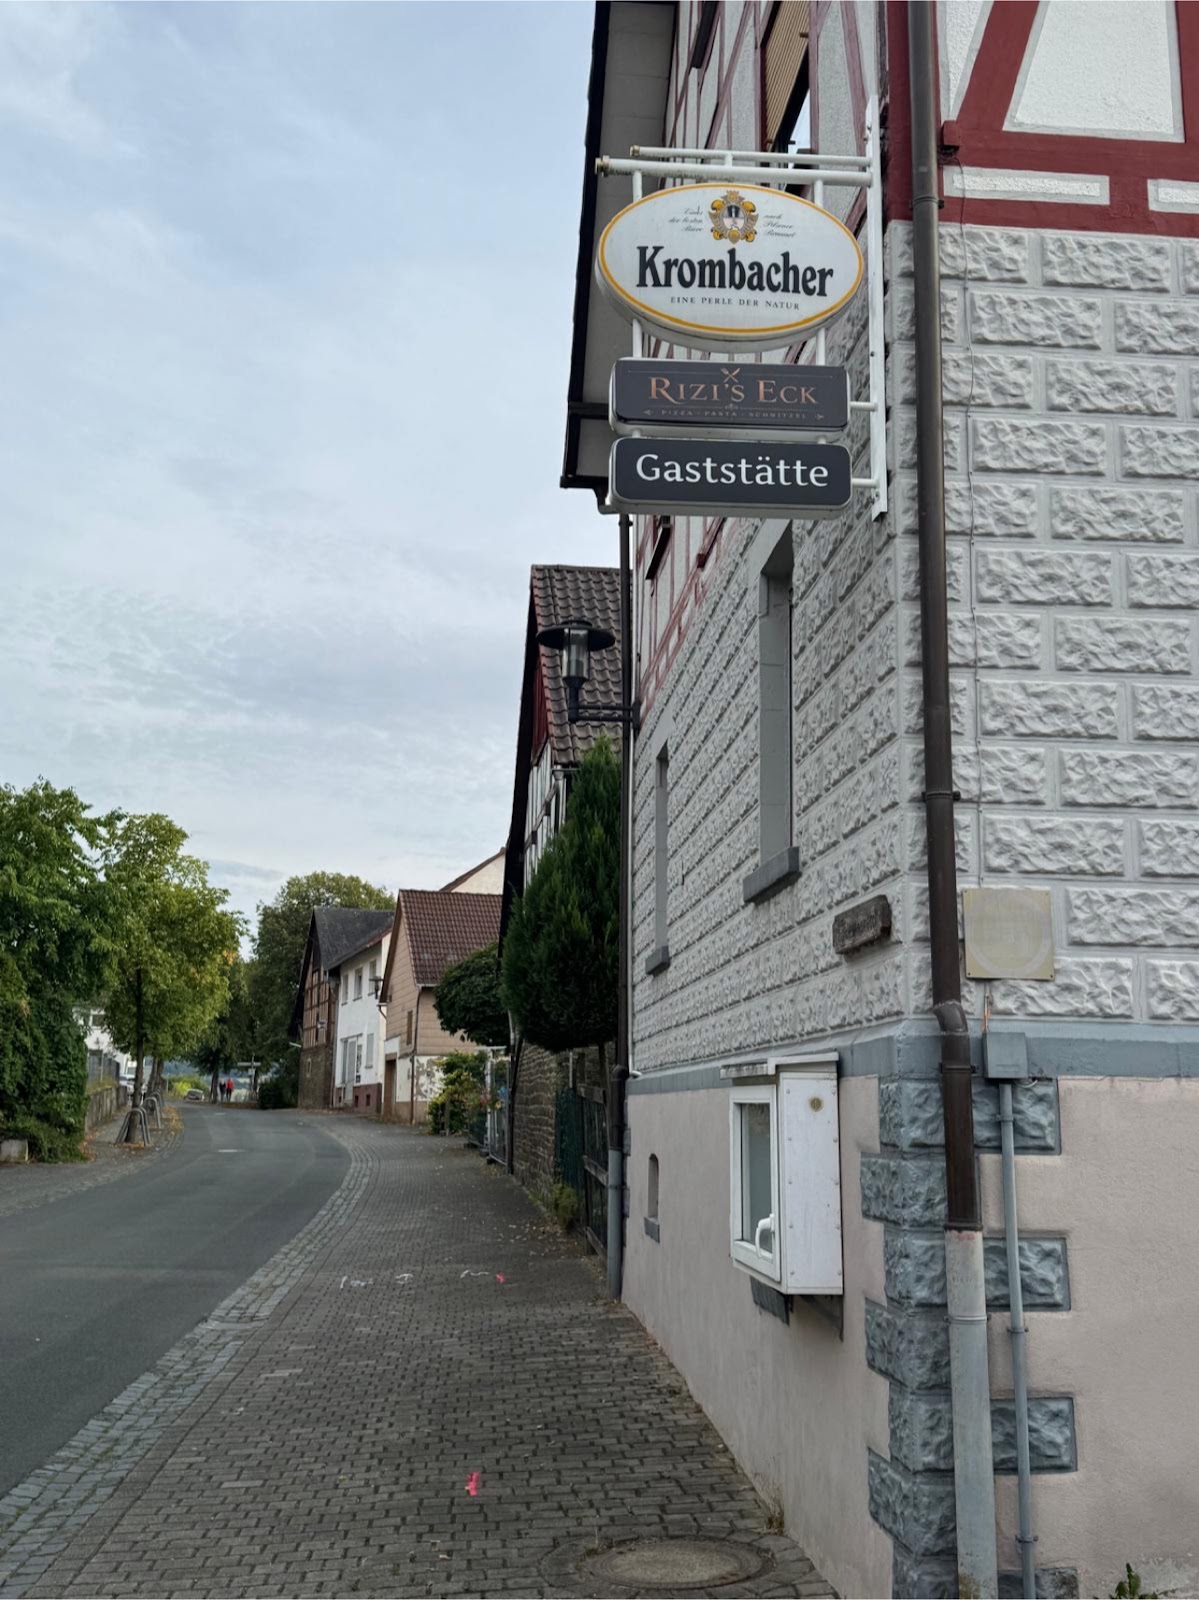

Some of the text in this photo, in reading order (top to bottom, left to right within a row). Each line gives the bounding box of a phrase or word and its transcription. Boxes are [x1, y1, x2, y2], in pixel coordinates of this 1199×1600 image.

[636, 246, 834, 297] Krombacher
[670, 296, 800, 310] EINE PERLE DER NATUR
[757, 379, 819, 404] ECK
[636, 453, 829, 487] Gaststätte
